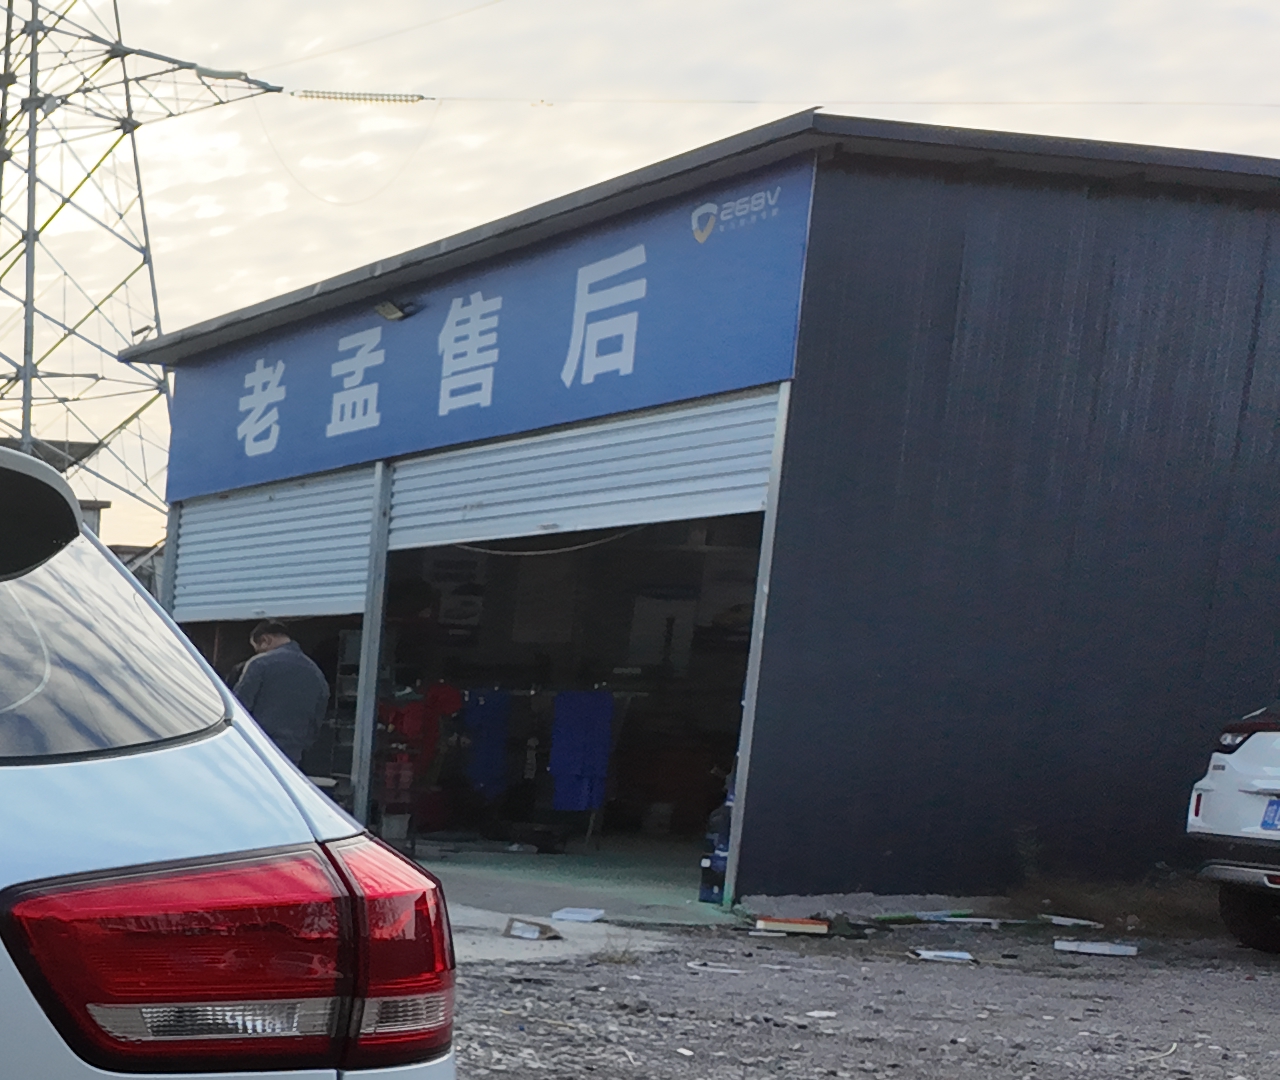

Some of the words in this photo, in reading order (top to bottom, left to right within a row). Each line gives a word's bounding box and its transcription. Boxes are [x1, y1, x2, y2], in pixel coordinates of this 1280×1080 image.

[720, 186, 781, 221] 268V
[237, 244, 647, 457] 老孟售后
